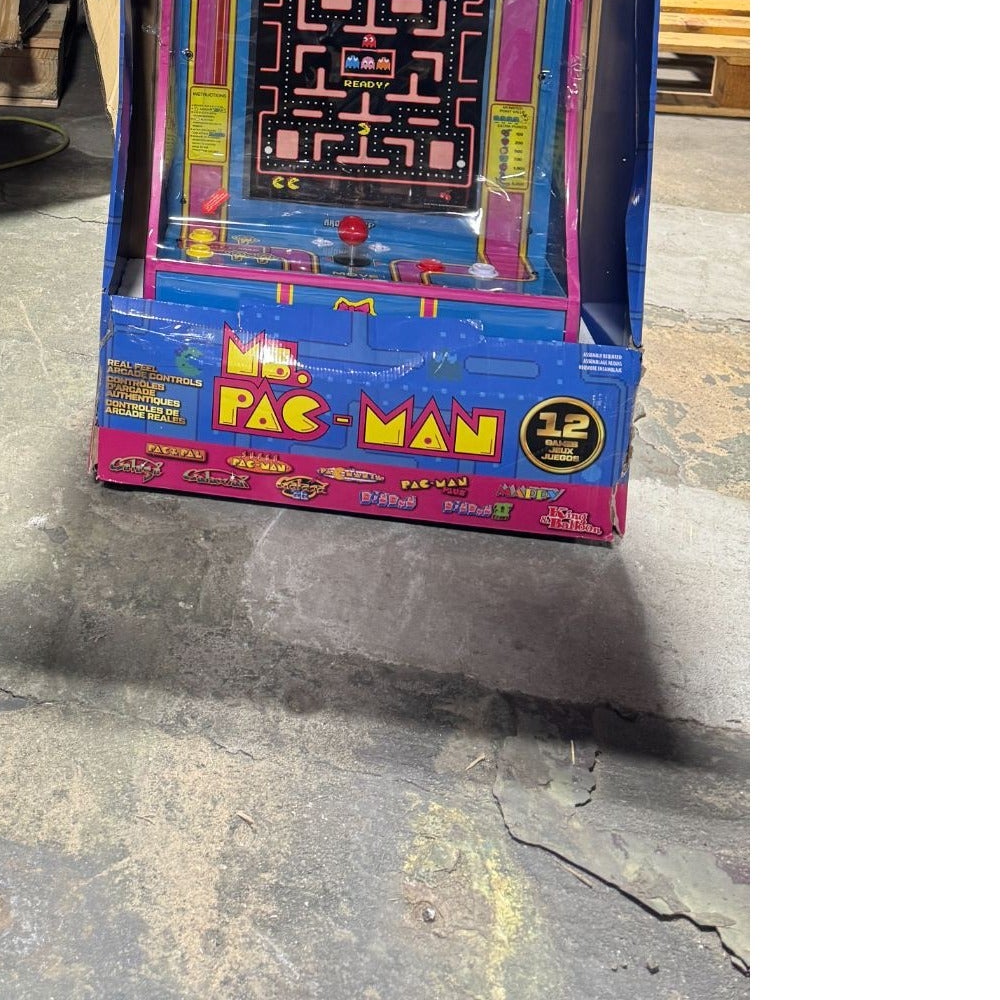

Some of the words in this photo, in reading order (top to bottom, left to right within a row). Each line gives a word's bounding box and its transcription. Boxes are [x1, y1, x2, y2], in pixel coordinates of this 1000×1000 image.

[343, 79, 391, 90] READY!
[107, 358, 133, 369] REAL
[134, 362, 157, 373] FEEL
[107, 366, 148, 378] ARCADE
[149, 372, 203, 387] CONTROLS
[106, 391, 181, 408] AUTHENTIQUES
[105, 400, 163, 414] CONTROLES
[165, 408, 179, 417] DE
[105, 406, 146, 419] ARCADE
[147, 412, 186, 425] REALES
[536, 412, 590, 440] 12
[544, 439, 579, 448] GAMES
[548, 447, 574, 455] JEUX
[231, 458, 287, 472] PAC-MAN
[540, 453, 580, 462] JUEGOS
[400, 477, 468, 490] PAC-MAN
[496, 483, 566, 501] MAPPY
[547, 505, 588, 521] King
[549, 517, 603, 535] Balloon
